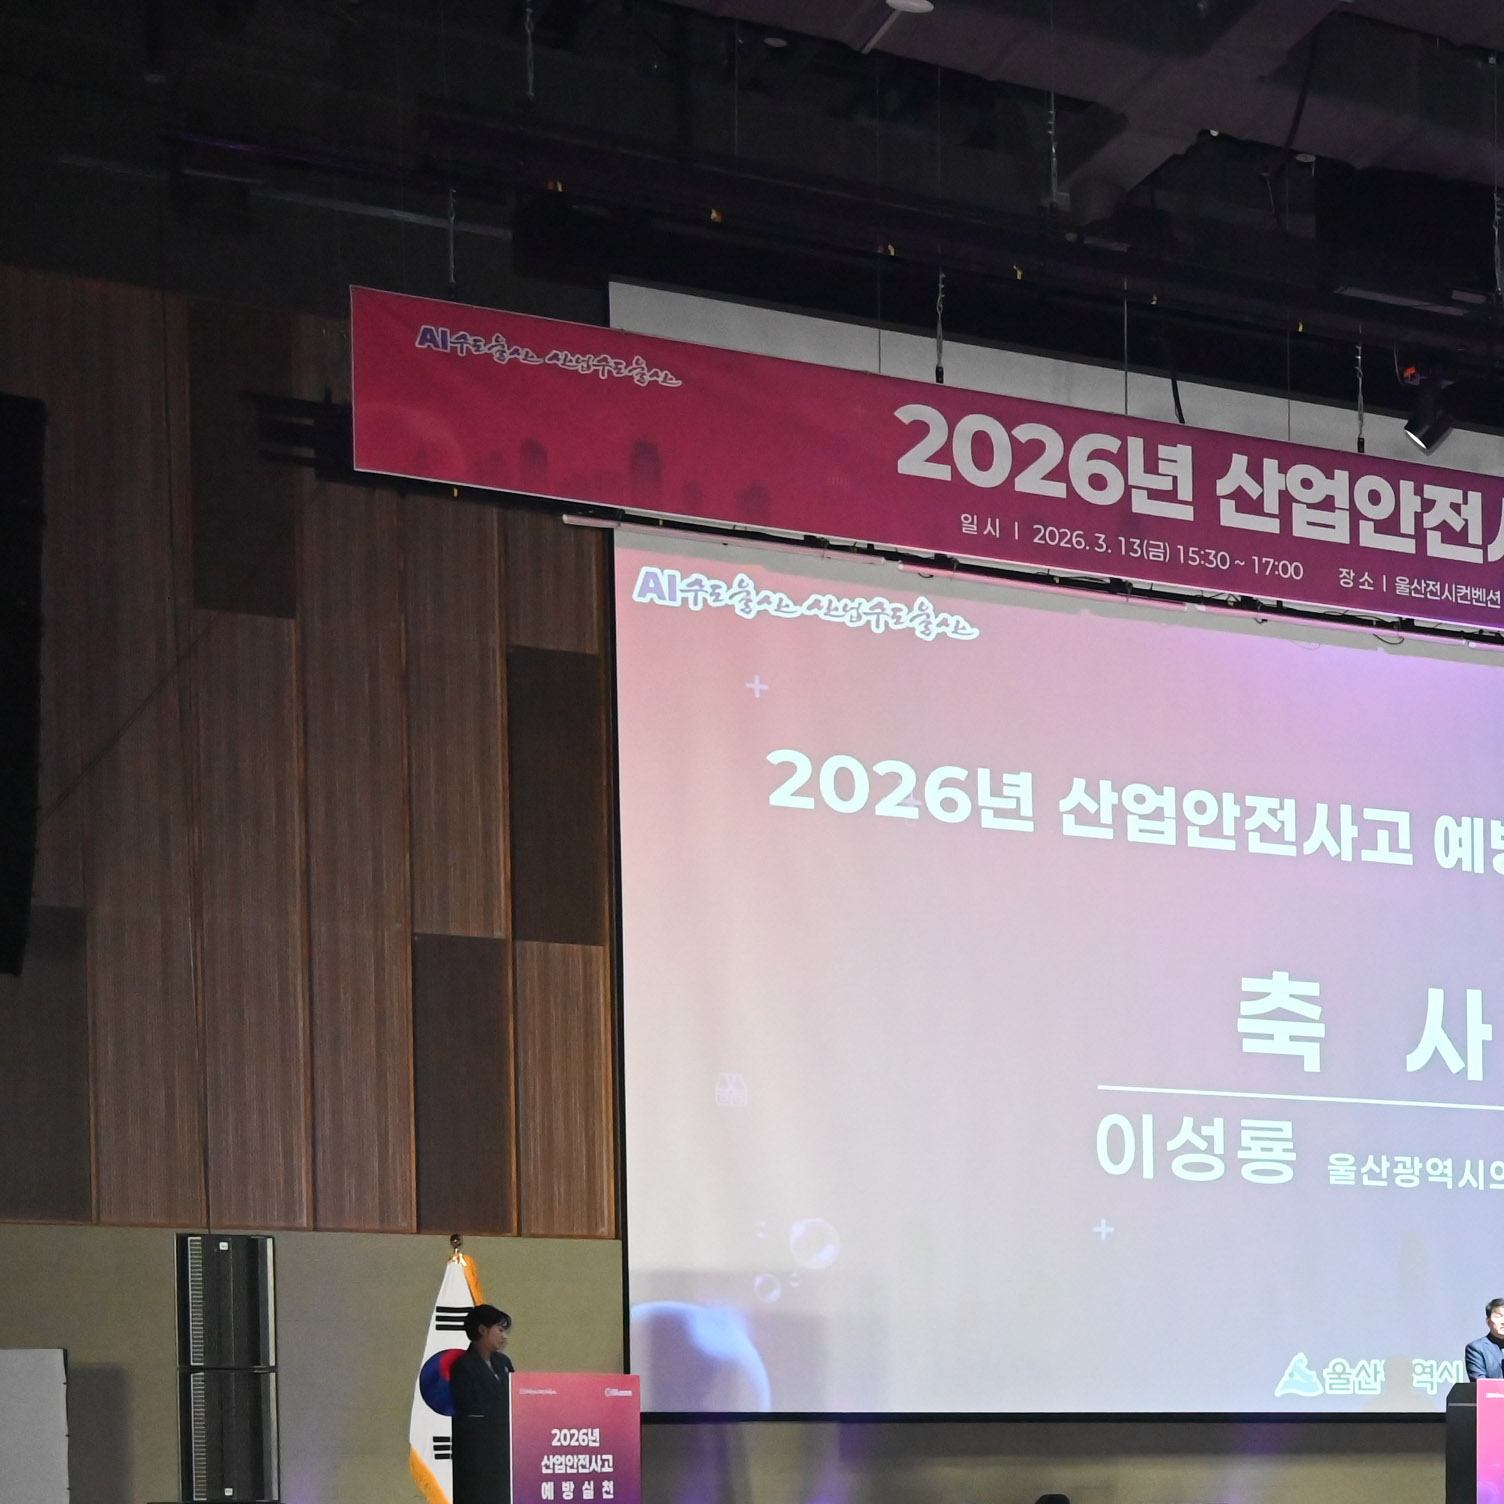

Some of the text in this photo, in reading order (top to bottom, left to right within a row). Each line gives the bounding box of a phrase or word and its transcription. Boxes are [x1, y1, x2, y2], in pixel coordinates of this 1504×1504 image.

[894, 404, 1194, 521] 2026년
[1118, 537, 1170, 563] 13(금)
[1177, 545, 1230, 571] 15:30
[1252, 556, 1303, 580] 17:00
[633, 566, 800, 619] AI수도울산
[1395, 575, 1501, 609] 울산전시컨벤션
[766, 749, 1034, 832] 2026년
[1059, 777, 1413, 865] 산업안전사고
[1096, 1113, 1296, 1184] 이성룡
[1323, 1358, 1464, 1395] 울산역시
[551, 1428, 600, 1447] 2026년
[541, 1455, 613, 1474] 산업안전사고
